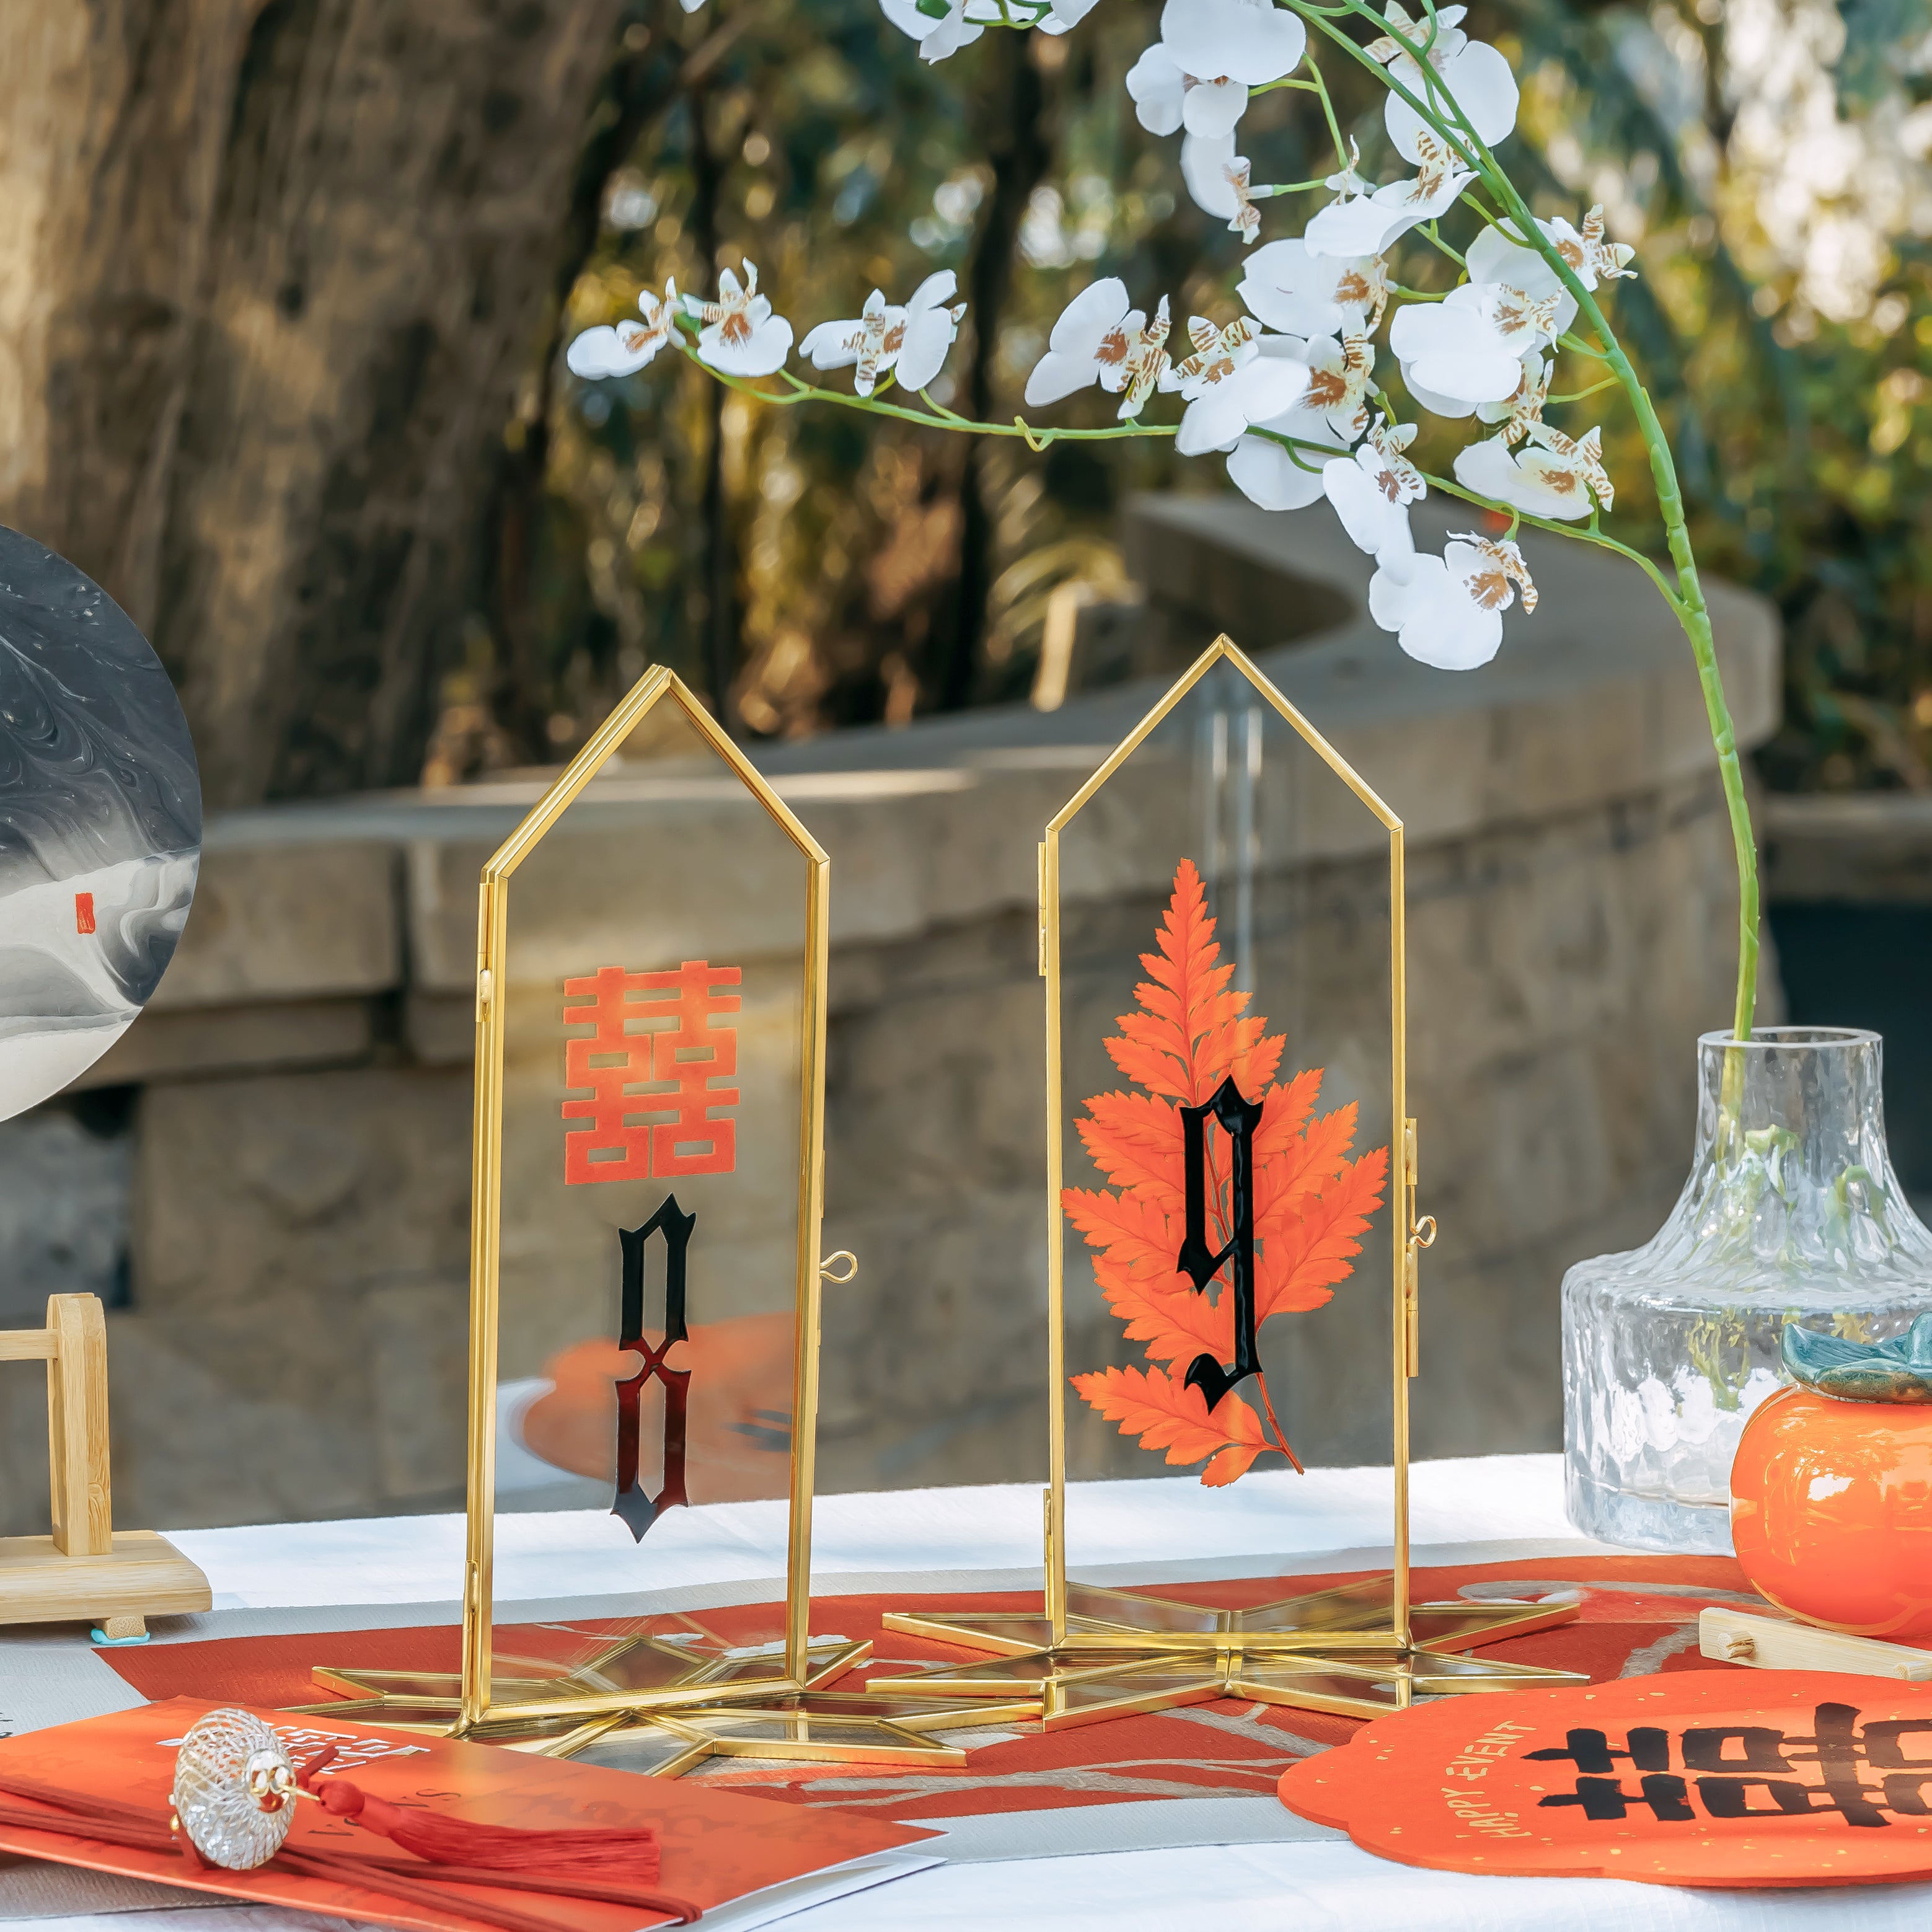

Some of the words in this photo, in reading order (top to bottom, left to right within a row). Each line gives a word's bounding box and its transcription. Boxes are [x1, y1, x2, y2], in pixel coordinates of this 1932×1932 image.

[562, 959, 743, 1185] 囍
[1176, 1074, 1263, 1414] 9
[611, 1192, 697, 1543] 8
[1440, 1787, 1532, 1838] HAPPY
[1445, 1720, 1537, 1781] EVENT
